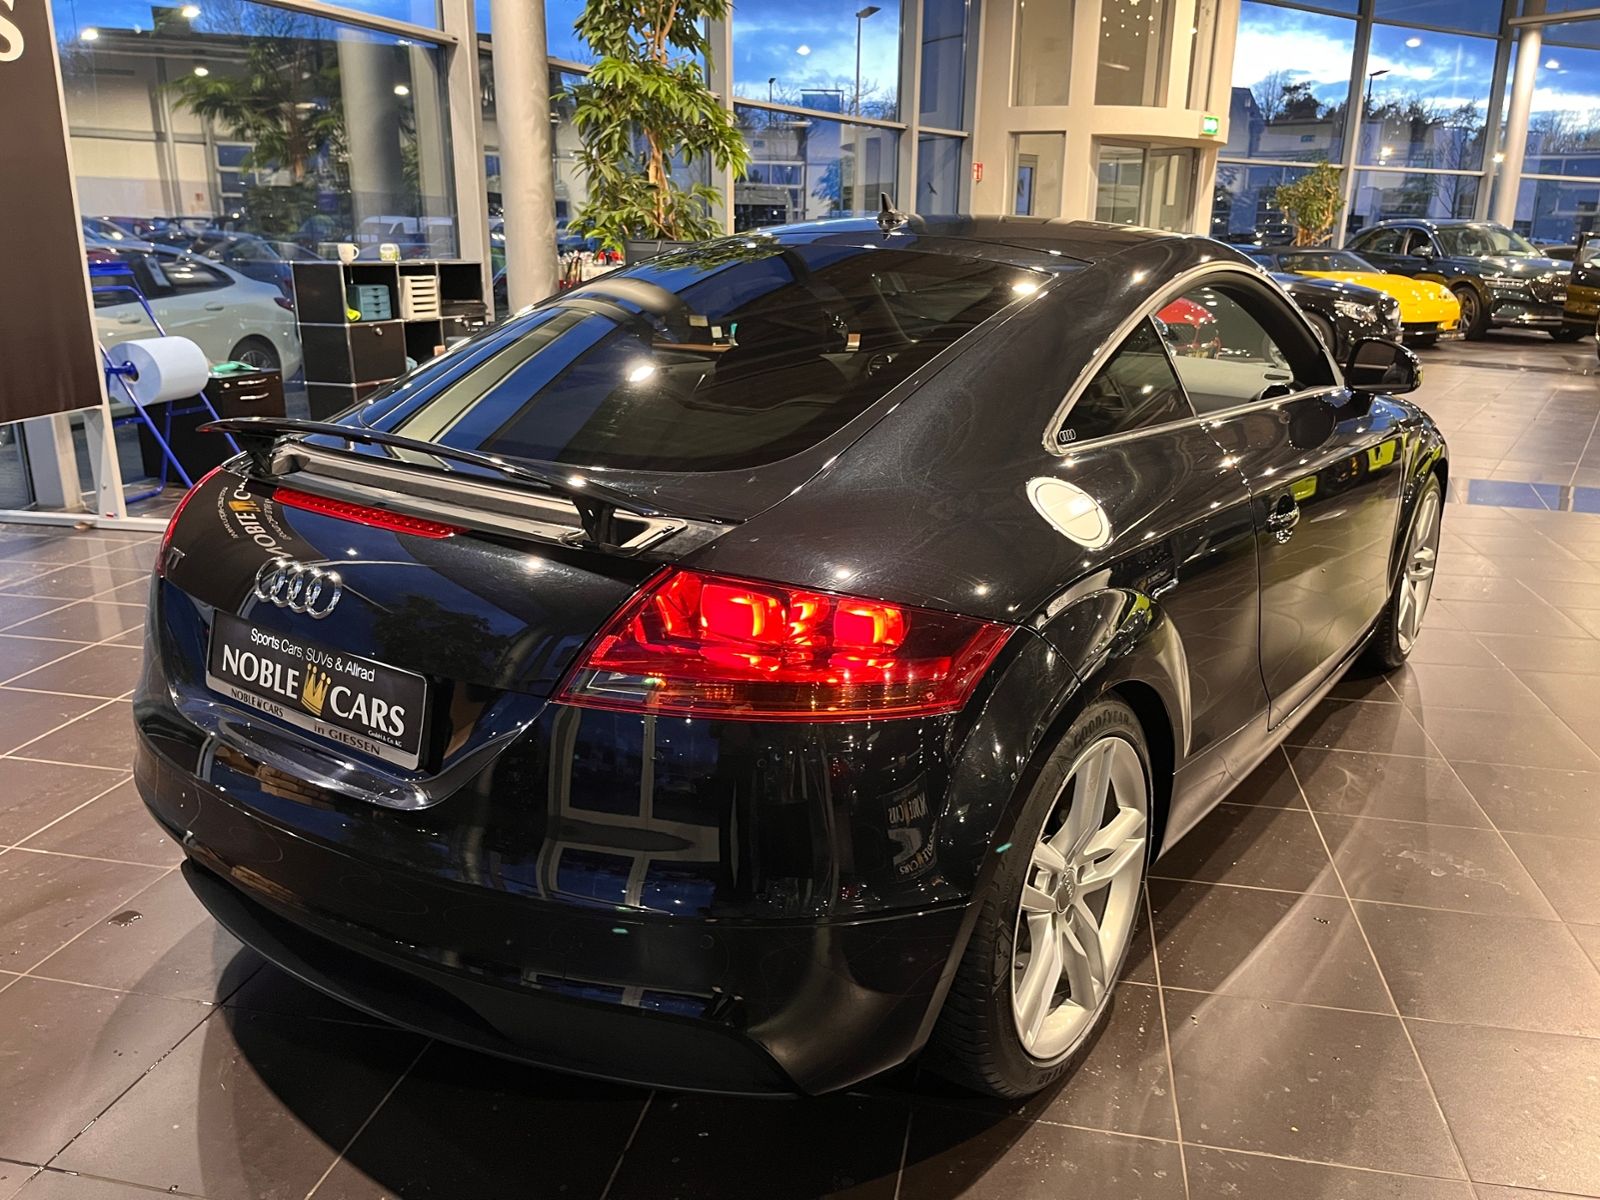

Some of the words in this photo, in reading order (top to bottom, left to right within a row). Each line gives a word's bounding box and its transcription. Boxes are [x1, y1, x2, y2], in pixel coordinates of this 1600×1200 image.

[250, 627, 280, 651] Sports
[281, 639, 304, 661] Cars,
[305, 647, 334, 670] SUVs
[334, 657, 343, 672] &
[344, 660, 375, 682] Allrad
[222, 644, 300, 700] NOBLE
[330, 685, 406, 737] CARS
[231, 688, 257, 707] NOBLE
[263, 701, 284, 718] CARS
[314, 724, 325, 736] in
[328, 728, 380, 756] GIESSEN
[1074, 709, 1129, 749] GOODYEAR
